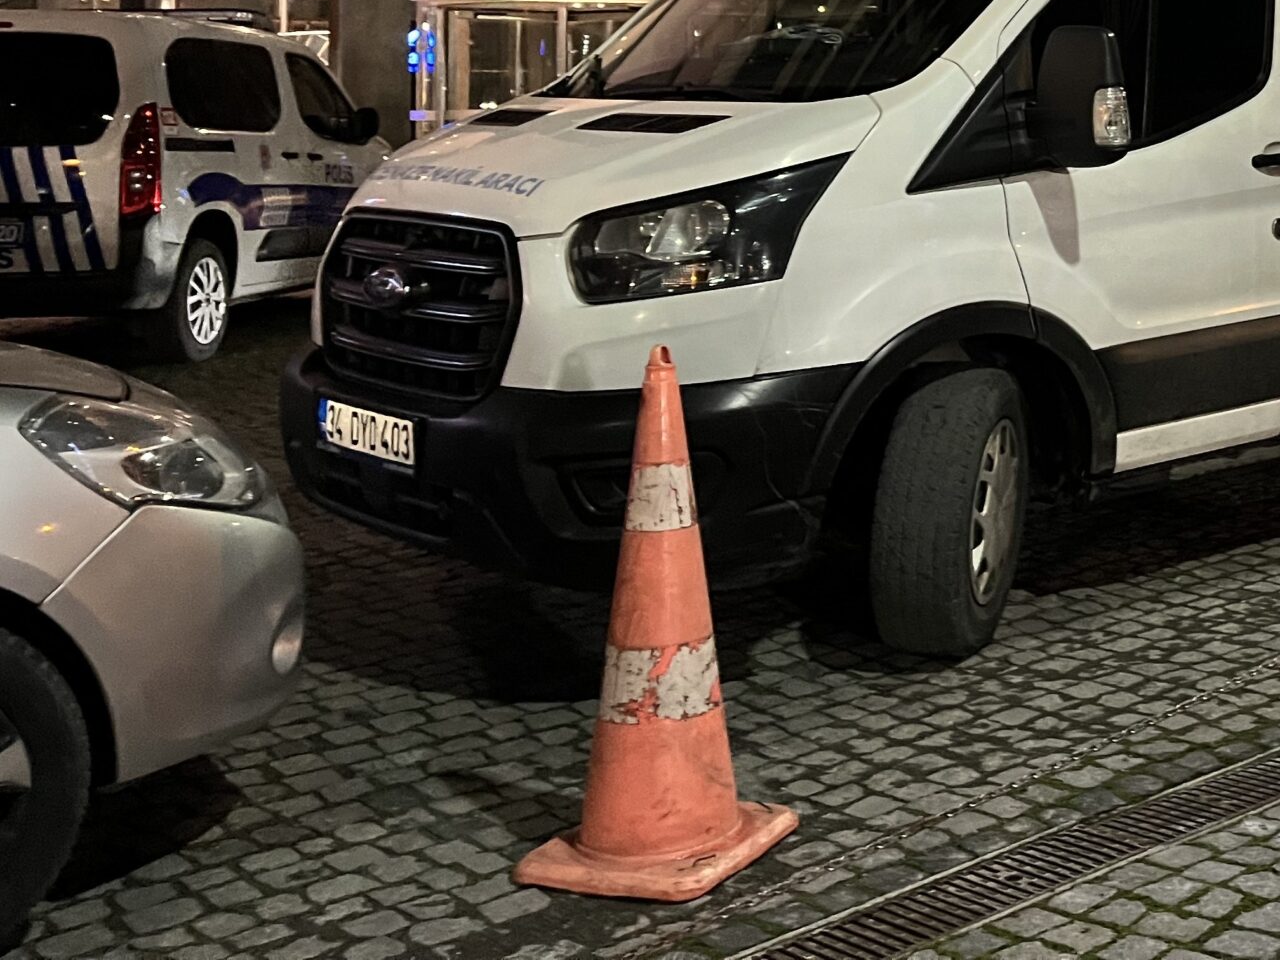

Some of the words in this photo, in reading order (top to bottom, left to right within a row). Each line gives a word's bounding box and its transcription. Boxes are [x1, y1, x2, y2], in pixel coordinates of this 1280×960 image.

[474, 171, 546, 198] ARACI
[328, 404, 342, 441] 34
[351, 411, 376, 451] DYD
[381, 419, 410, 460] 403
